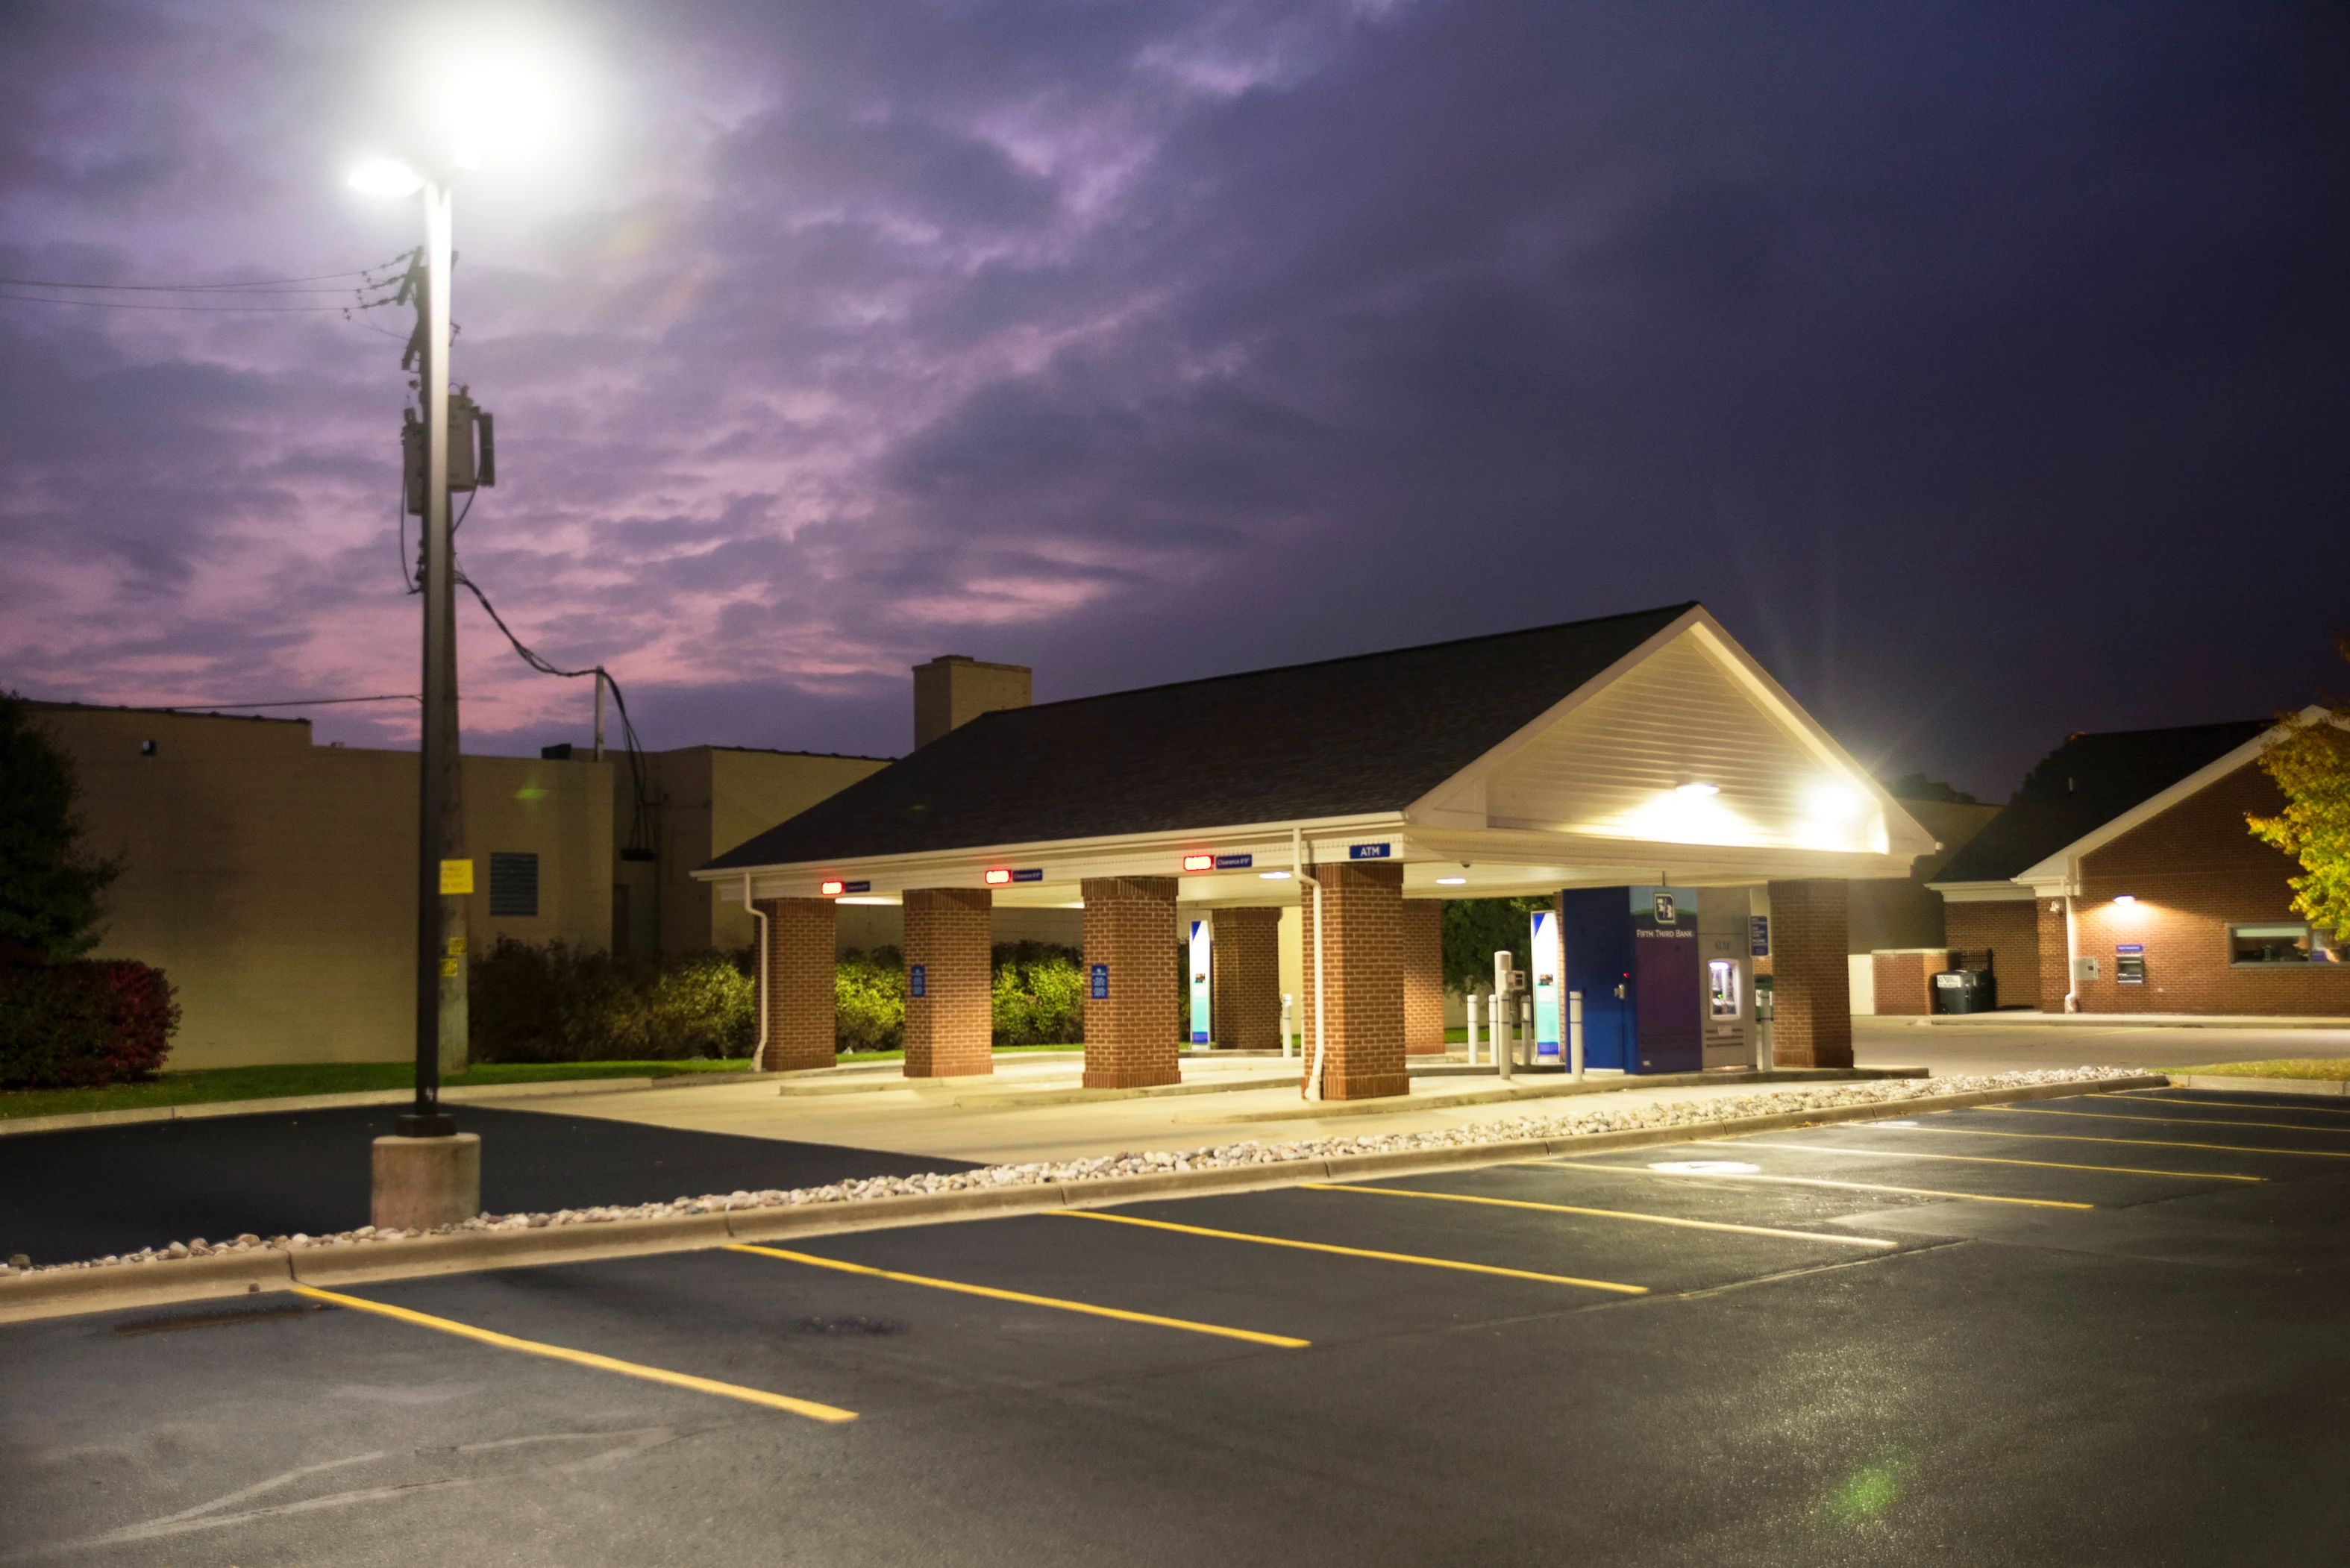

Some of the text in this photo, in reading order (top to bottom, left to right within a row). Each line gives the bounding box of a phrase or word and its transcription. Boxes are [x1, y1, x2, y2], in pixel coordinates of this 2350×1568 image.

[1359, 846, 1380, 857] ATM
[1636, 929, 1693, 938] FIFTH THIRD BANK
